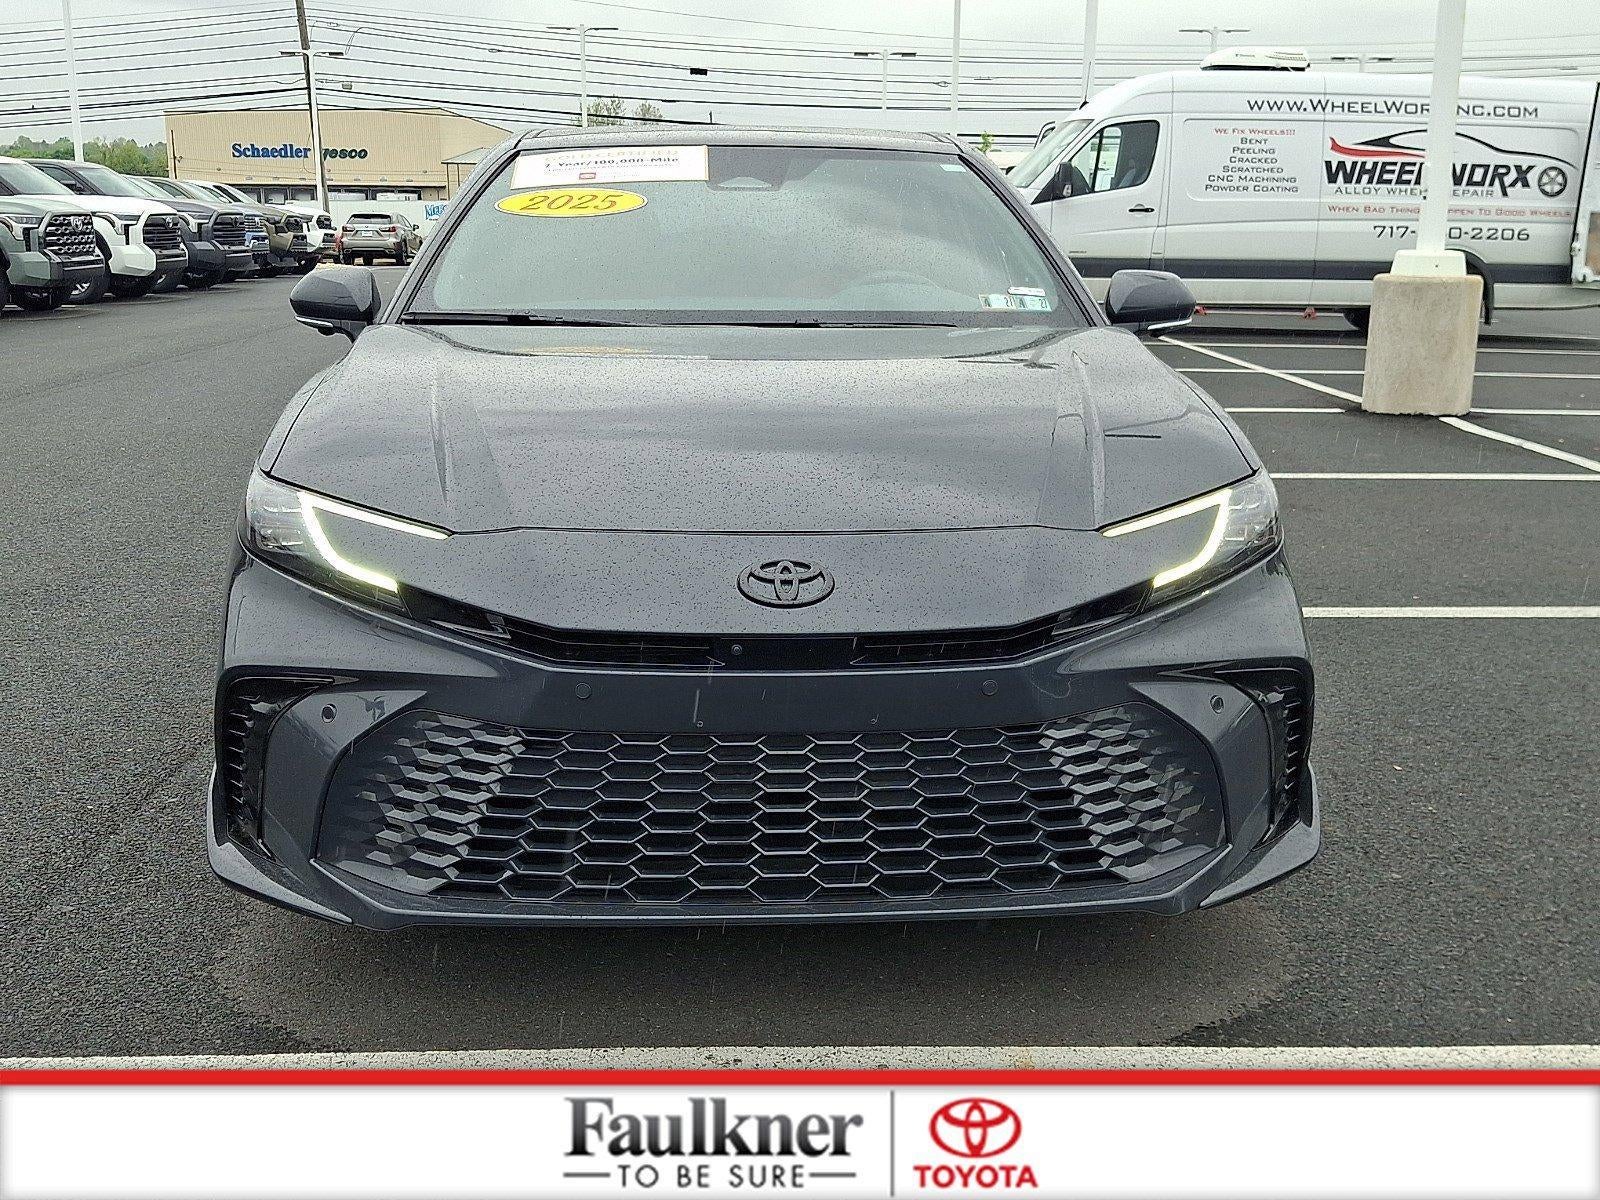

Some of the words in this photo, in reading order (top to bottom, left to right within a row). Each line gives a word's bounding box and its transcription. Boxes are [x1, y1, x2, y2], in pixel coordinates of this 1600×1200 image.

[1246, 98, 1539, 118] WWW.WHEELWORNC.COM
[1240, 137, 1268, 145] BENT
[231, 142, 312, 159] Schaedler
[1232, 146, 1276, 155] PEELING
[1229, 156, 1278, 165] CRACKED
[1222, 165, 1284, 174] SCRATCHED
[1207, 174, 1234, 183] CNC
[1238, 175, 1297, 184] MACHINING
[1204, 184, 1249, 192] POWDER
[1253, 184, 1299, 193] COATING
[1334, 186, 1381, 195] ALLOY
[1386, 187, 1423, 197] WHE
[1452, 189, 1495, 197] EPAIR
[519, 194, 624, 211] 2025
[1390, 206, 1420, 214] THING
[1447, 208, 1474, 216] PPEN
[1373, 225, 1530, 241] 717-0-2206
